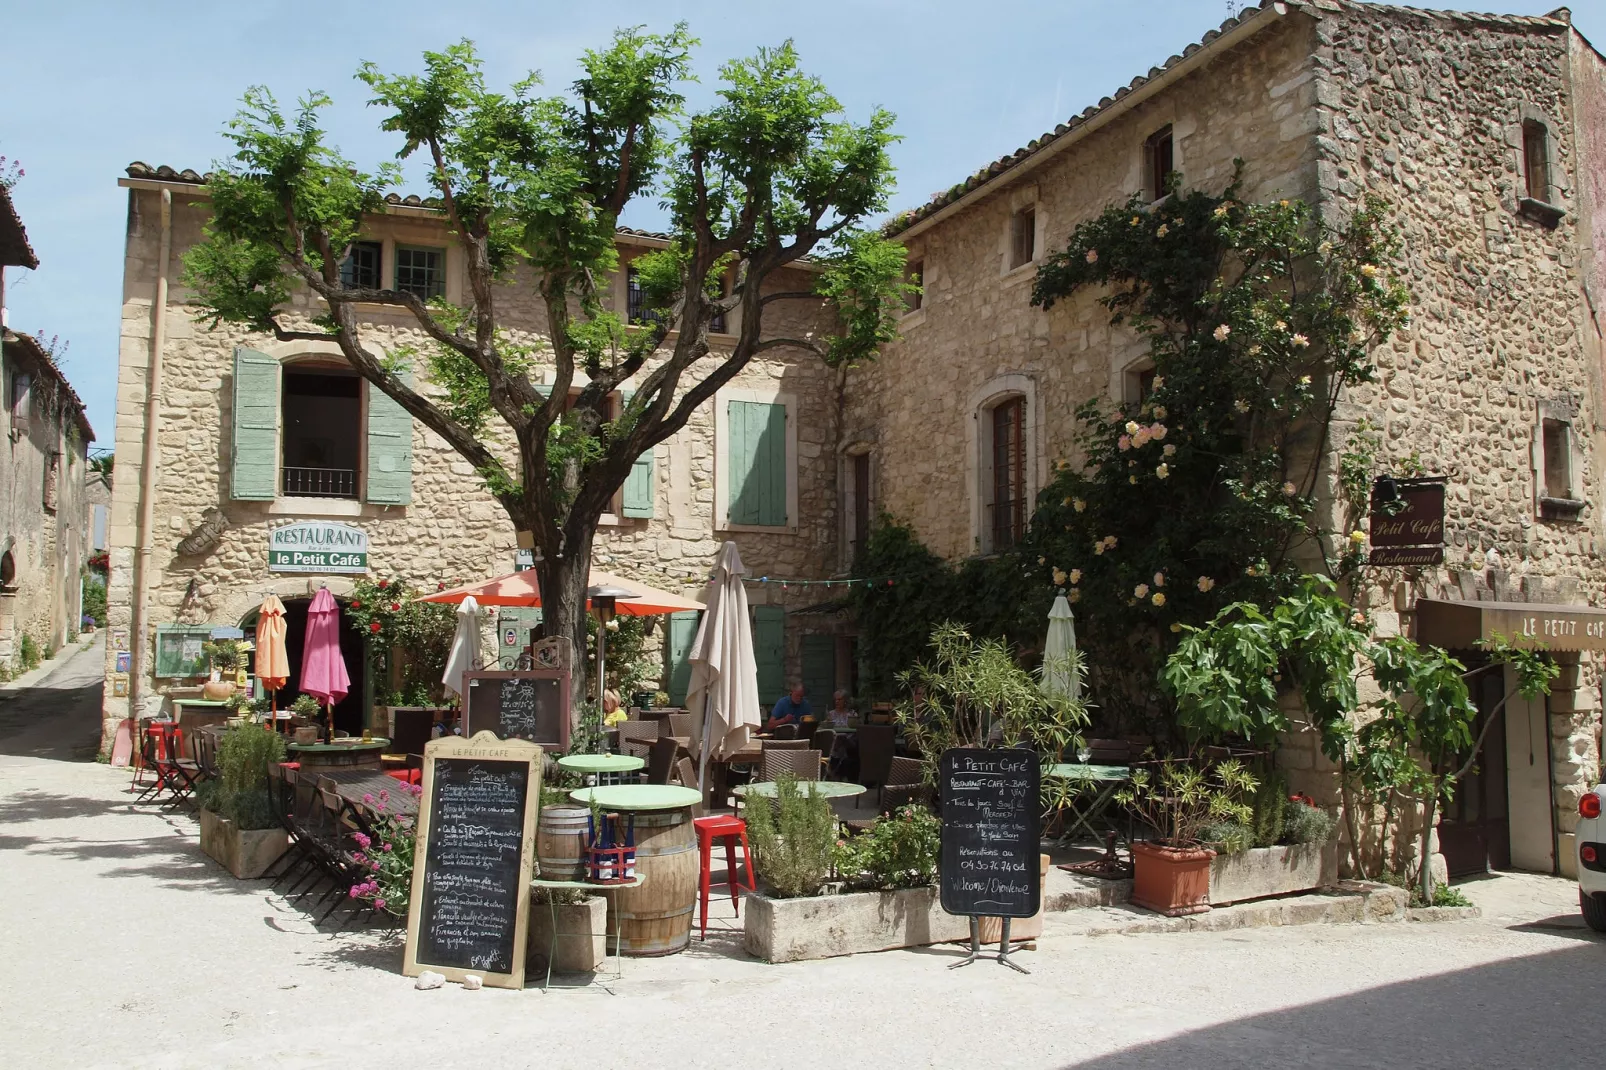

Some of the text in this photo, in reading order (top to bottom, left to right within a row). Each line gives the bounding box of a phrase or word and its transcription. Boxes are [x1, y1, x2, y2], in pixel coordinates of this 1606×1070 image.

[1374, 519, 1441, 539] Petit Café
[275, 527, 364, 546] RESTAURANT
[277, 552, 360, 566] le Petit Café
[1374, 551, 1438, 564] Restaurant
[1523, 617, 1605, 639] LE PETIT CAF
[452, 748, 509, 758] LE PETIT CAFE
[952, 757, 959, 769] le
[999, 758, 1028, 772] CAFÉ
[1009, 780, 1030, 789] BAR
[961, 860, 974, 871] 04
